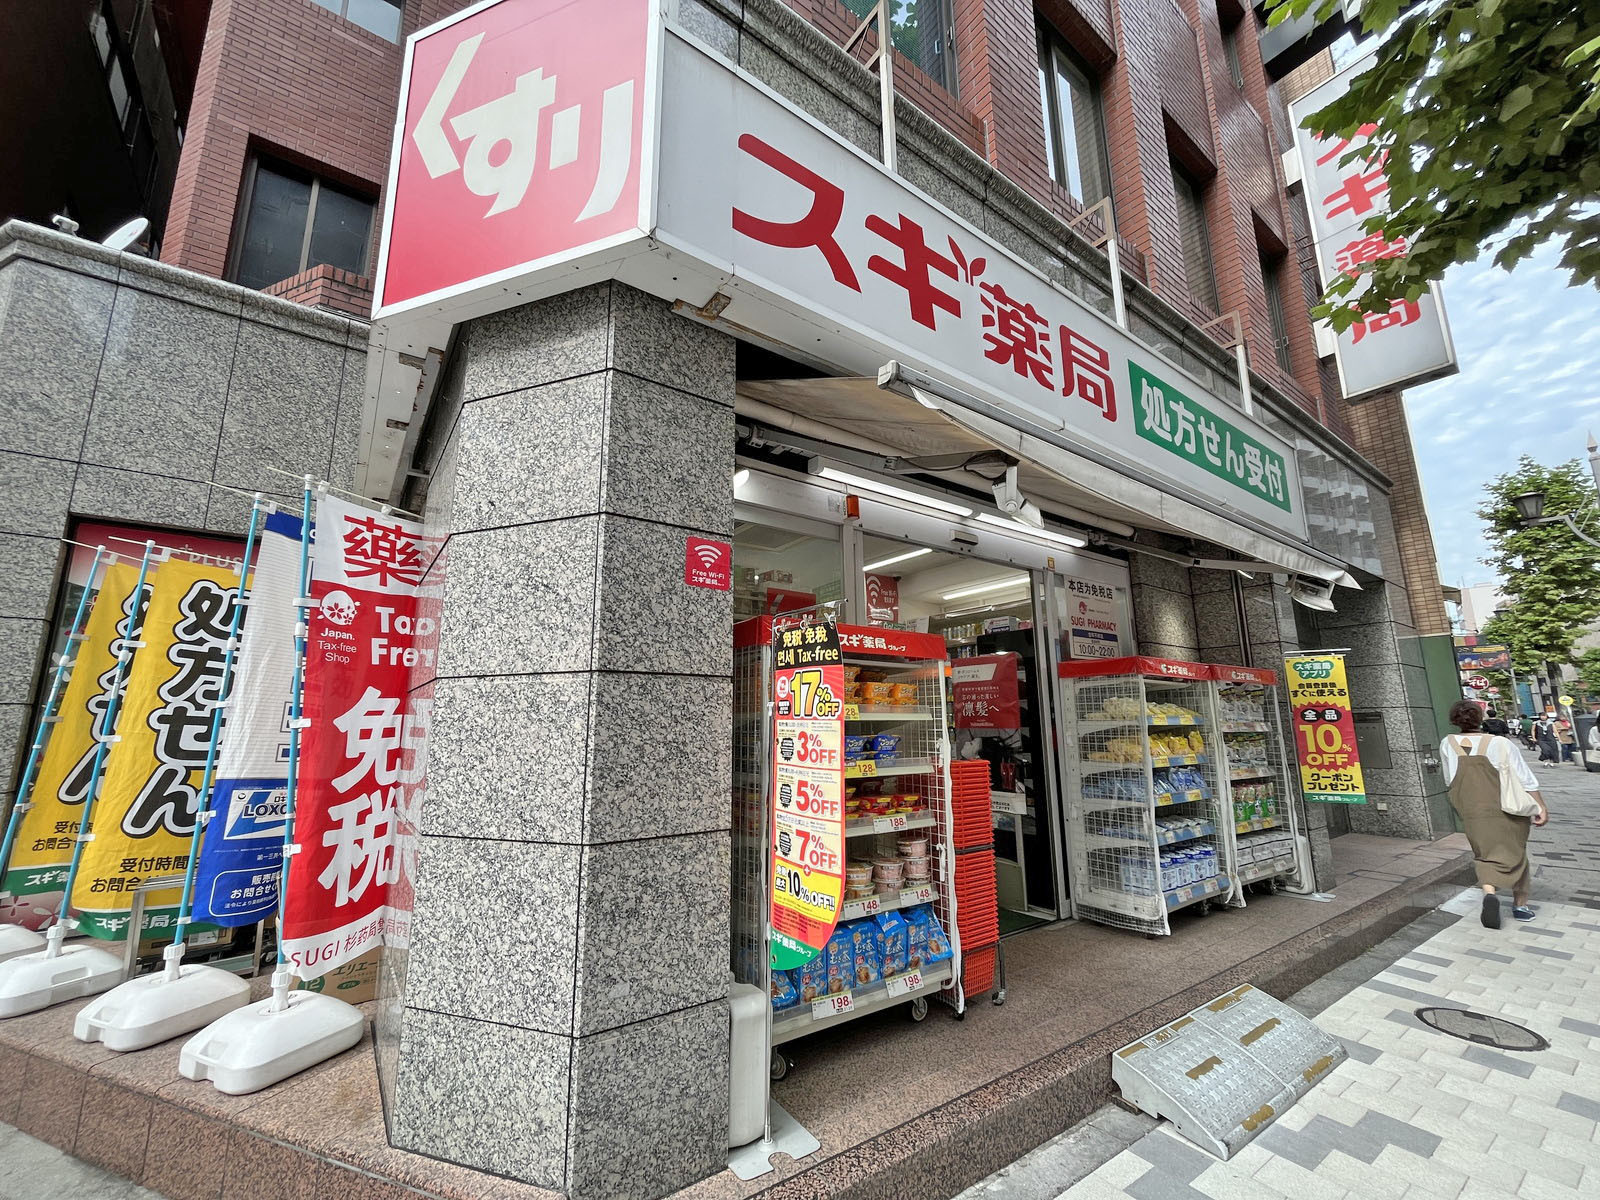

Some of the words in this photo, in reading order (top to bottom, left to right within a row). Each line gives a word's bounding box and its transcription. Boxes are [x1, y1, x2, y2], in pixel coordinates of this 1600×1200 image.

[412, 32, 634, 223] くすり
[732, 133, 1117, 423] スギ薬局
[1141, 378, 1284, 502] 処方せん受付
[692, 569, 707, 577] Free
[709, 572, 725, 580] Wi-Fi
[1068, 579, 1113, 600] 本店为免税店
[1071, 615, 1086, 627] SUGI
[1087, 618, 1117, 632] PHARMACY
[321, 628, 355, 641] Japan.
[317, 640, 357, 653] Tax-free
[325, 652, 350, 664] Shop
[777, 649, 795, 666] 면세
[797, 646, 839, 663] Tax-free
[1301, 670, 1326, 678] アプリ
[1291, 689, 1347, 698] すぐに使える
[816, 702, 840, 717] OFF
[1303, 709, 1338, 721] 全品
[809, 748, 837, 764] OFF
[1306, 753, 1349, 766] OFF
[857, 764, 873, 774] 128
[1310, 773, 1354, 782] クーポン
[1306, 782, 1360, 792] プレゼント
[810, 800, 839, 816] OFF
[889, 817, 904, 828] 188
[119, 856, 200, 873] 受付時間
[809, 850, 837, 869] OFF
[915, 888, 930, 899] 148
[861, 899, 878, 912] 148
[290, 940, 340, 968] SUGI
[903, 974, 920, 988] 198
[831, 995, 849, 1009] 198
